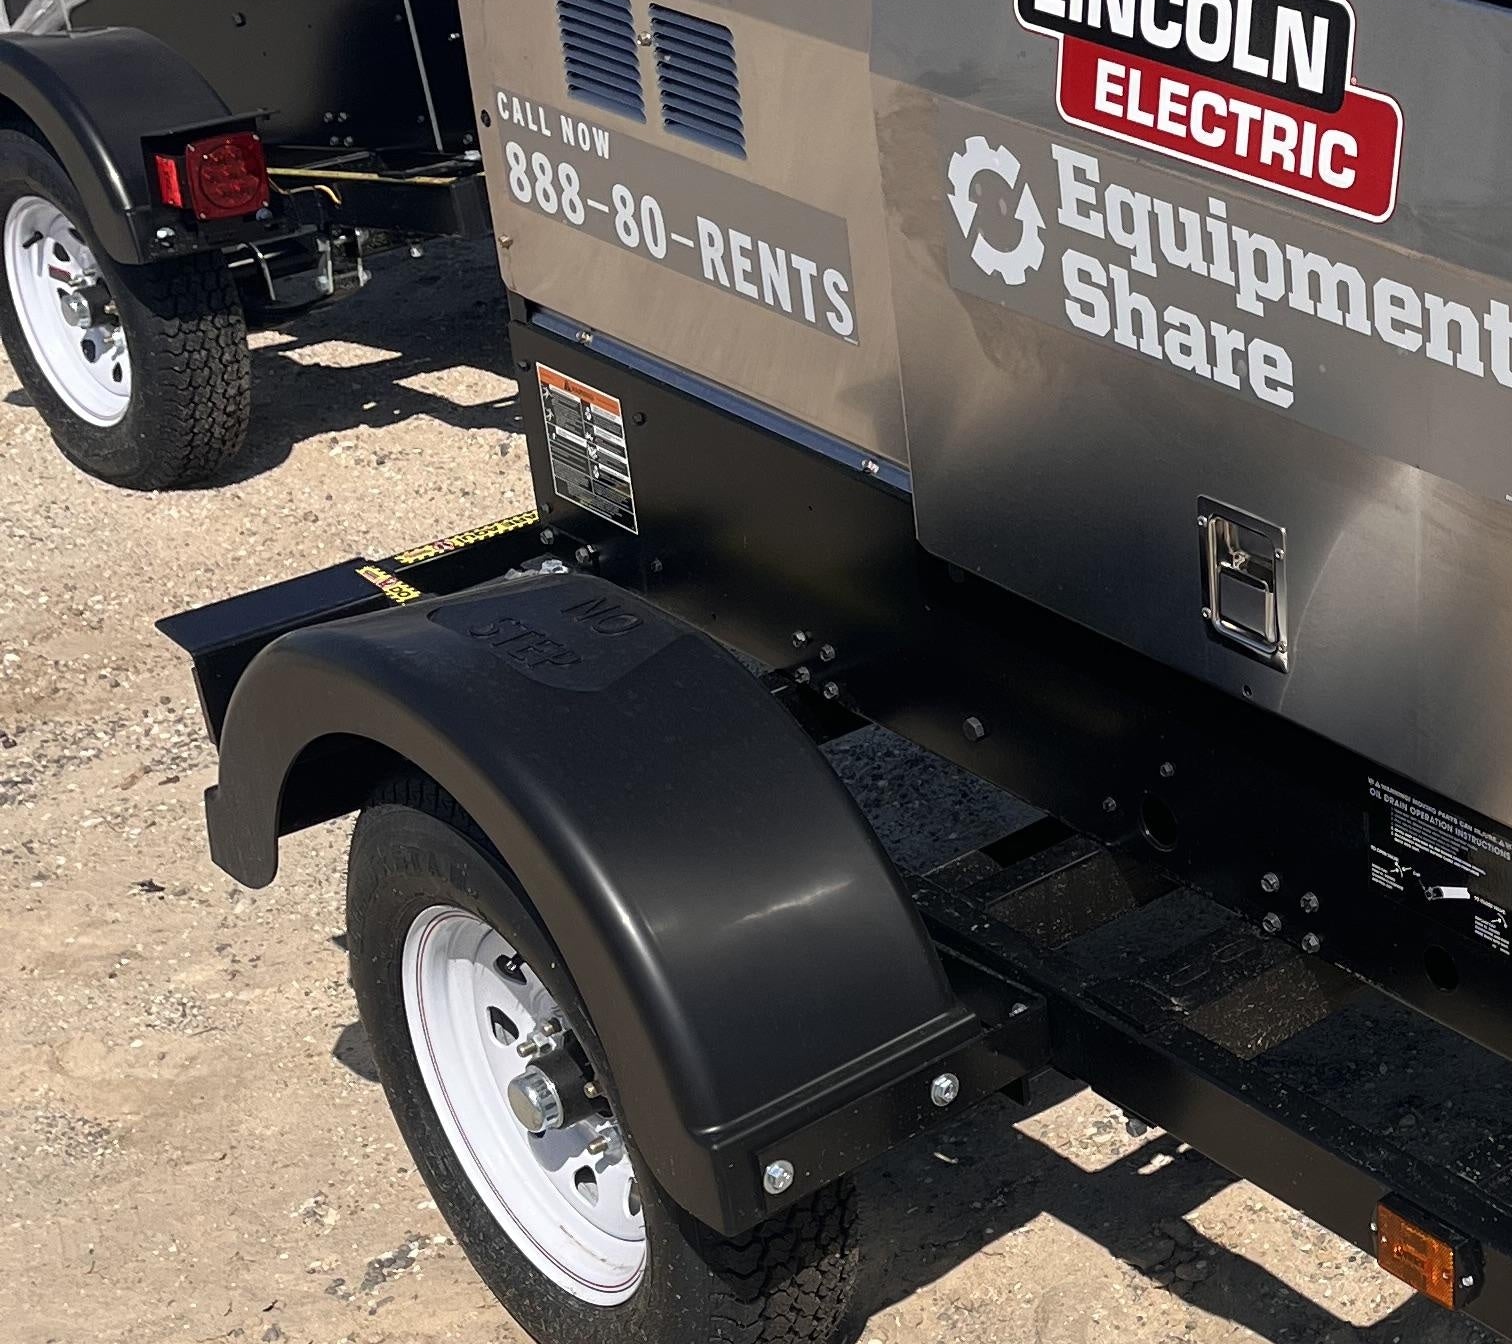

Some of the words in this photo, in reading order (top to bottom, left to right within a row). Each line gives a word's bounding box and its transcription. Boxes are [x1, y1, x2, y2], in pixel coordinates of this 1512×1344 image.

[497, 91, 552, 138] CALL
[561, 114, 611, 159] NOW
[1094, 57, 1359, 190] ELECTRIC
[505, 141, 854, 337] 888-80-RENTS
[1060, 248, 1294, 410] Share
[469, 617, 583, 670] STEP
[560, 597, 645, 636] NO
[1369, 787, 1382, 800] OIL
[1383, 793, 1408, 811] DRAIN
[1409, 806, 1453, 834] OPERATION
[1455, 827, 1511, 861] INSTRUCTIONS
